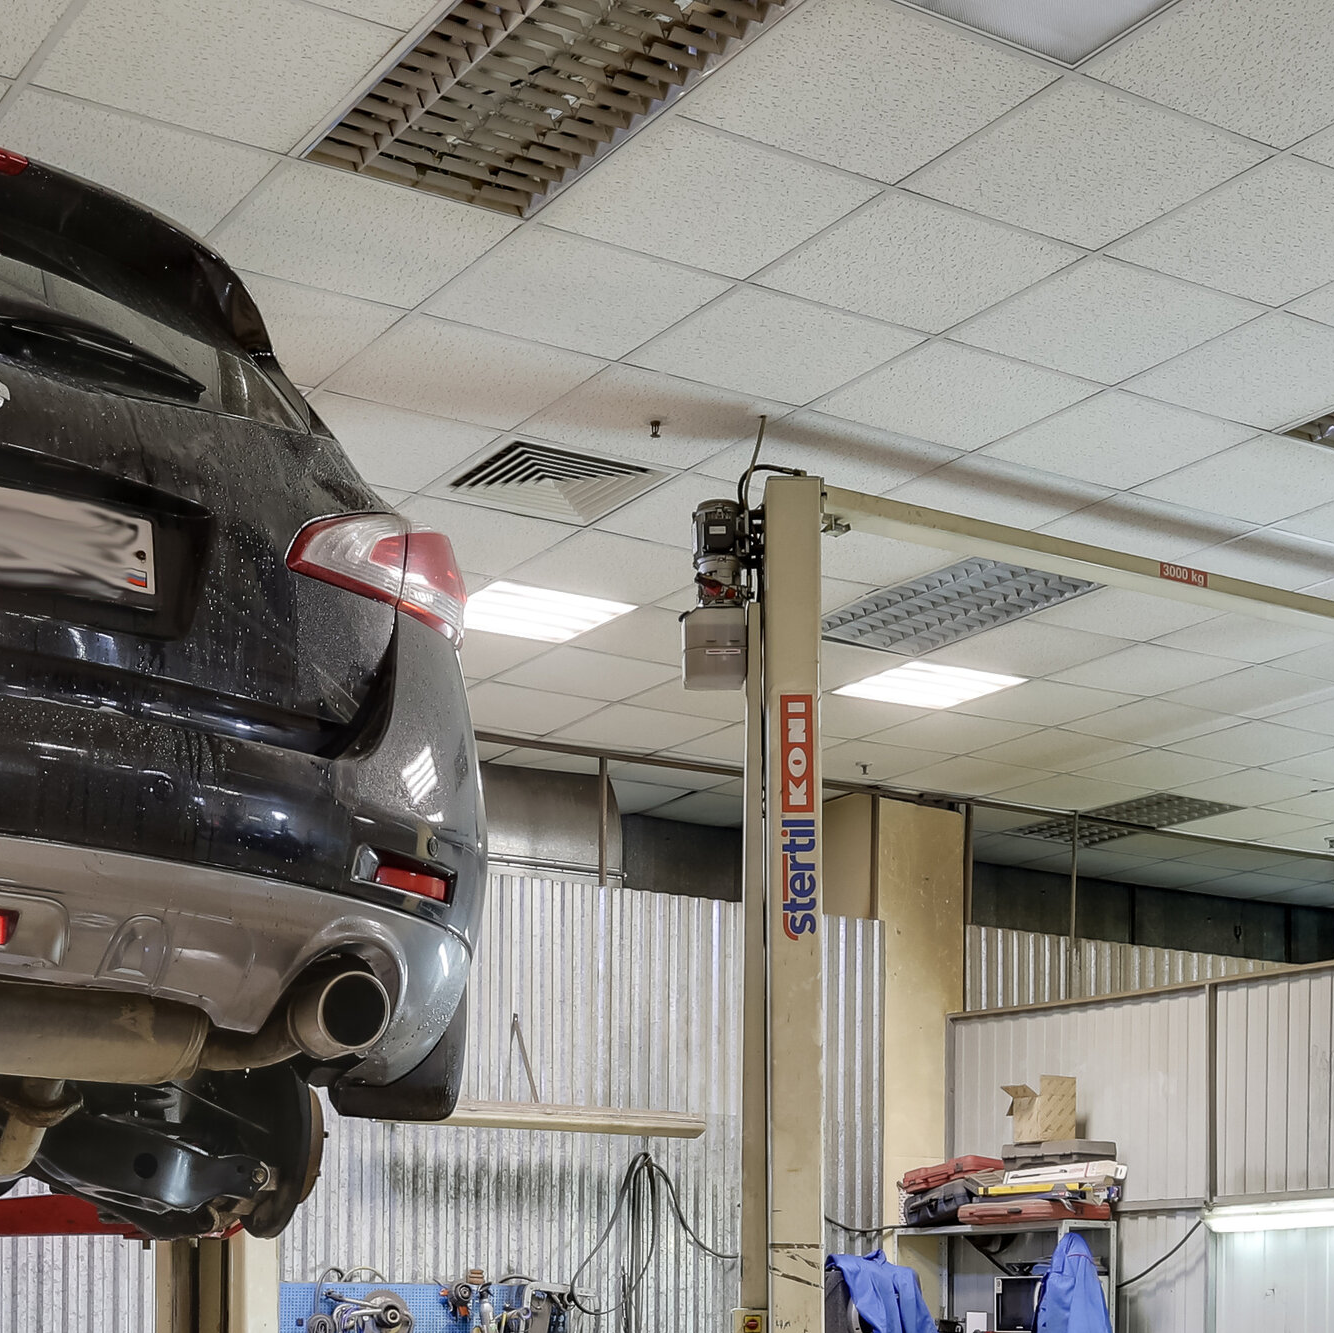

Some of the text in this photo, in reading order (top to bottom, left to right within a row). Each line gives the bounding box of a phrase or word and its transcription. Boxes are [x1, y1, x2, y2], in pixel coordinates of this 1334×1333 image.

[1162, 563, 1205, 587] 3000 kg
[780, 700, 817, 942] stertil KONI
